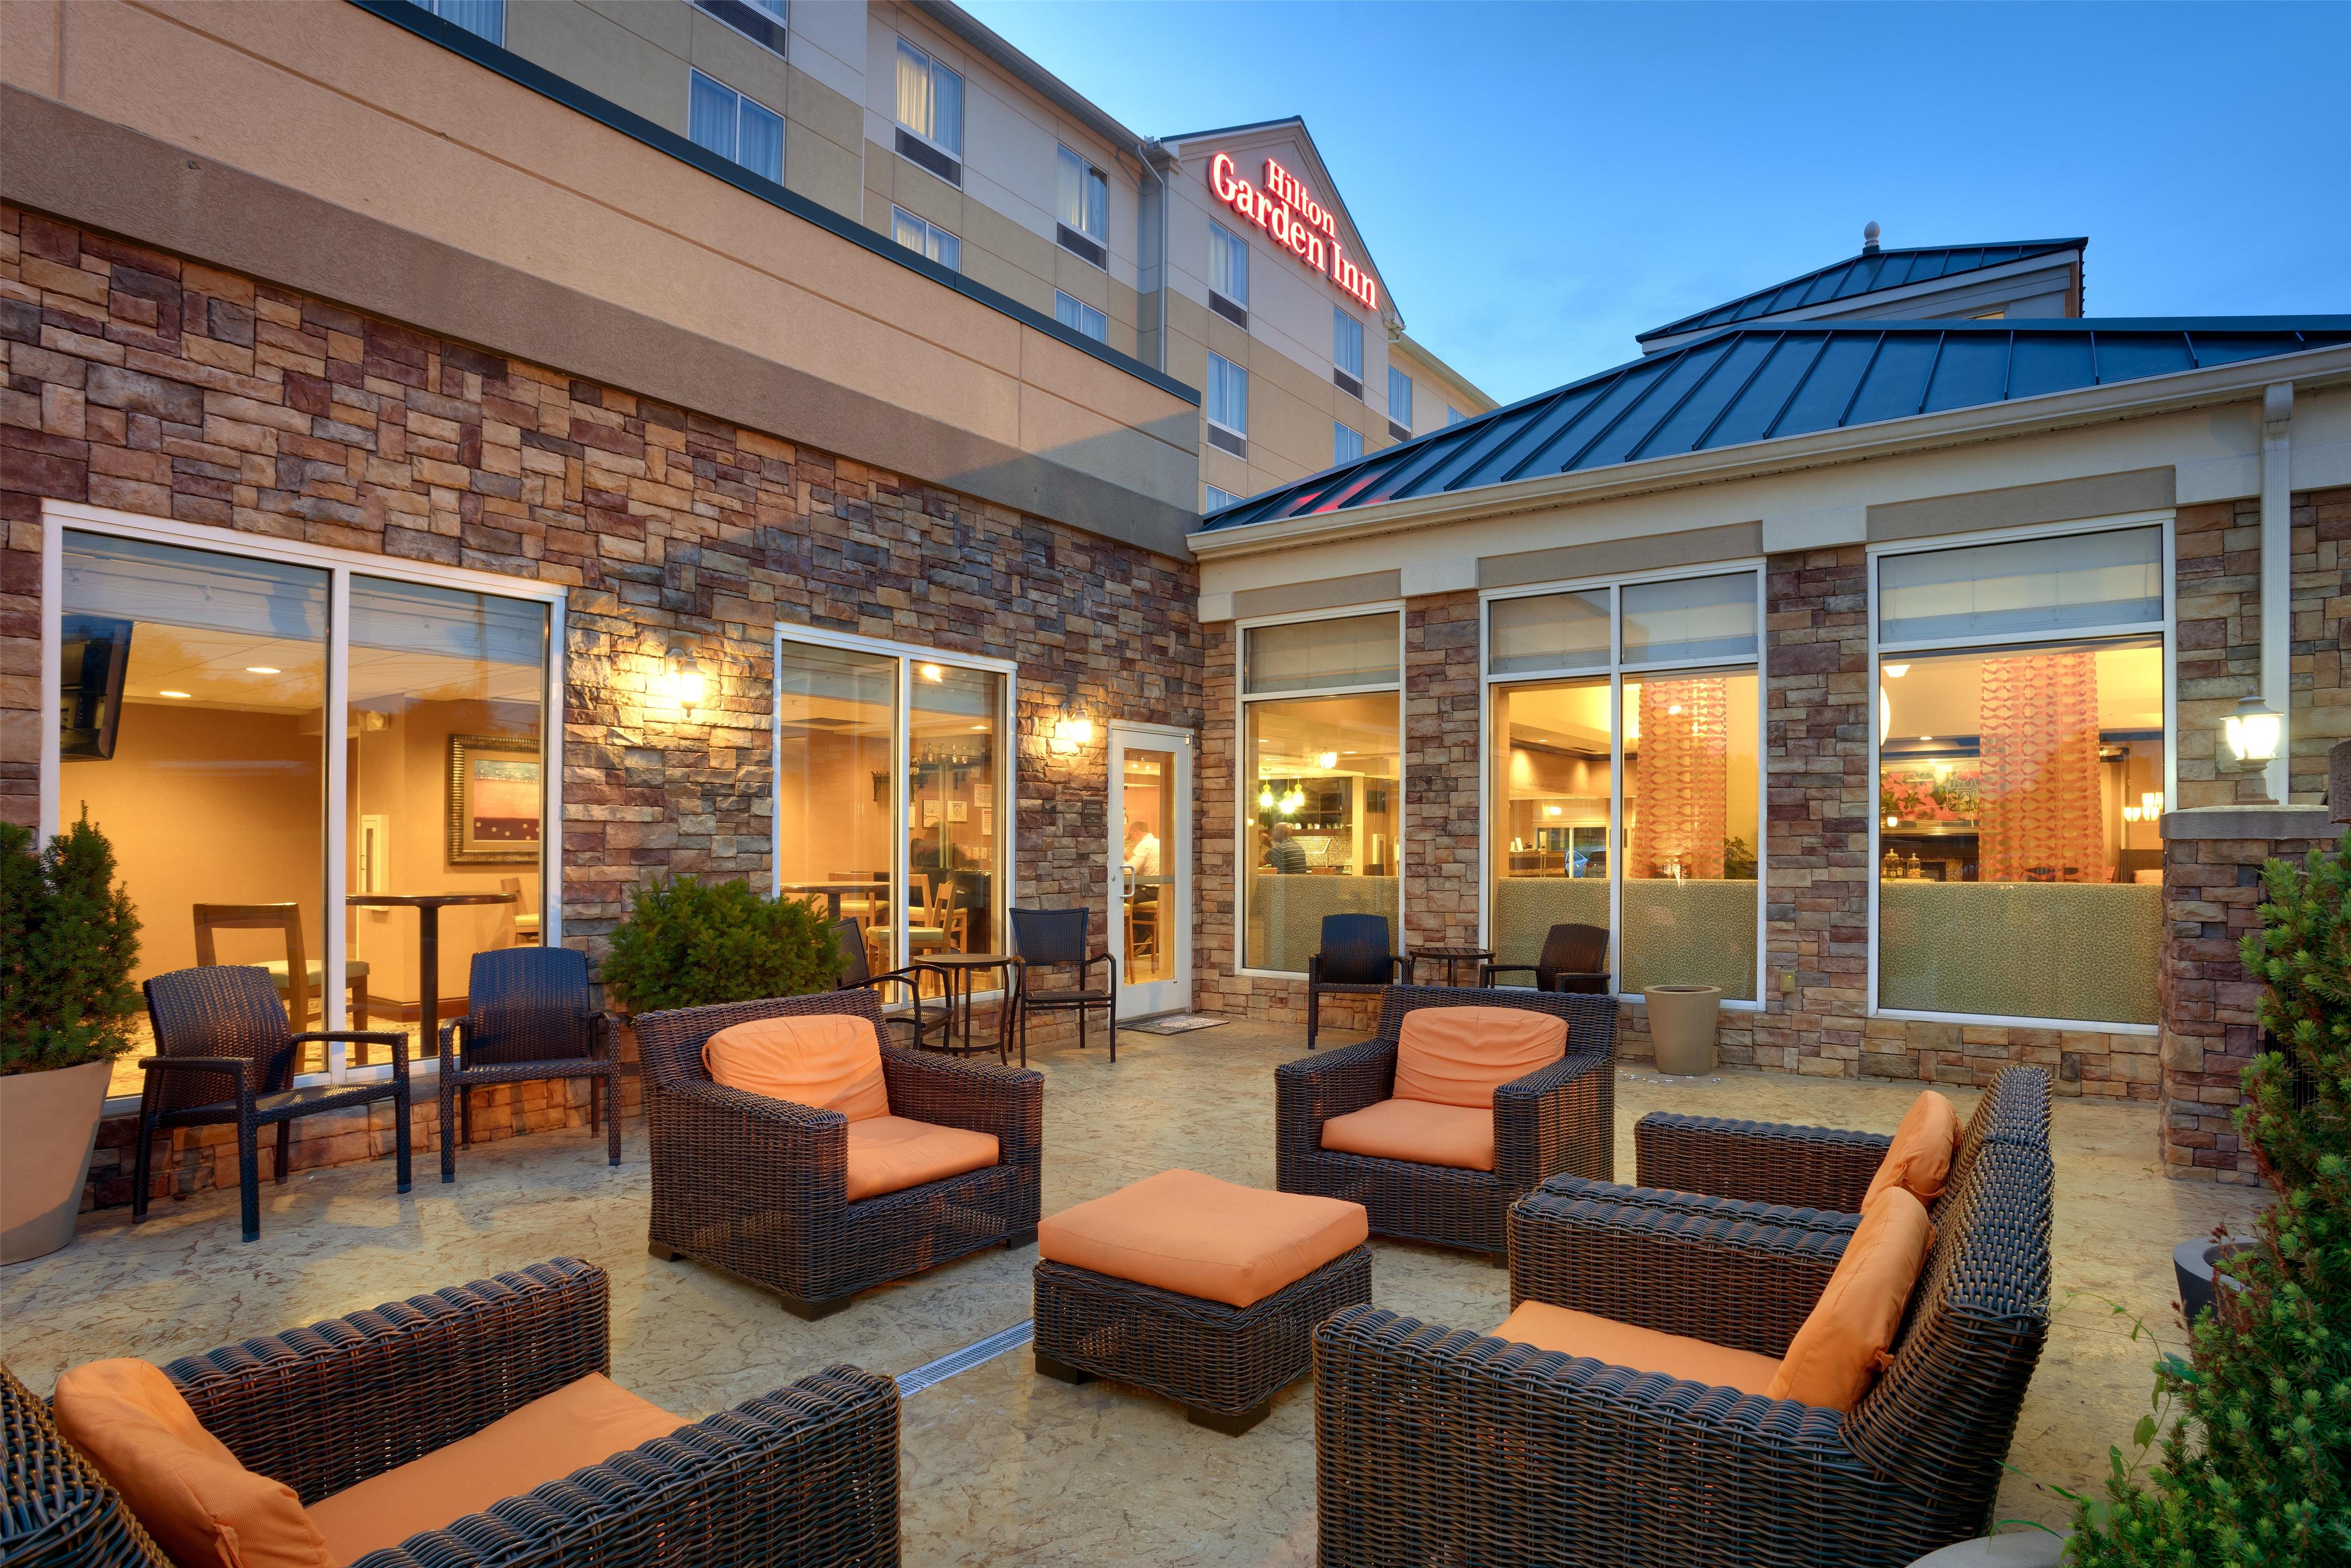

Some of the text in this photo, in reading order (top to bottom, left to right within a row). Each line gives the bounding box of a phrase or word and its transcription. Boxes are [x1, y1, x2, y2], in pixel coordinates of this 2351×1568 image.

[1212, 153, 1377, 310] Garden Inn
[1267, 157, 1336, 238] Hilton
